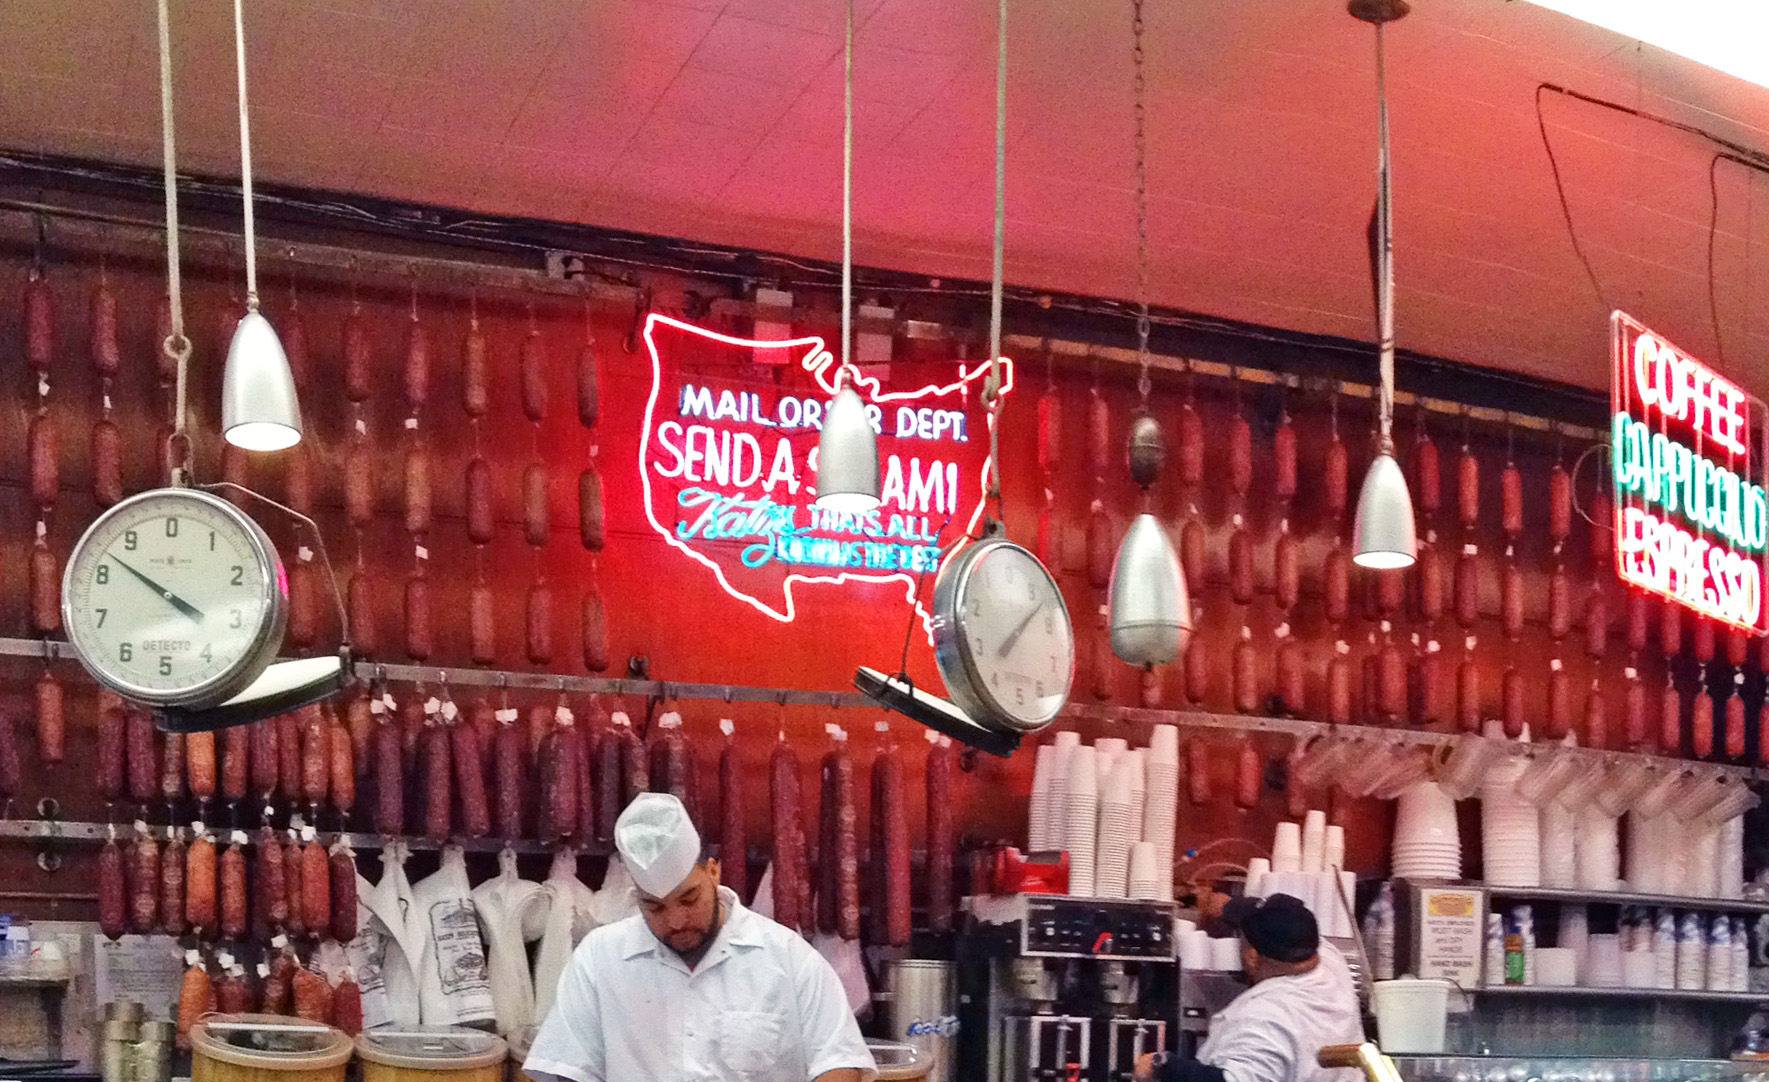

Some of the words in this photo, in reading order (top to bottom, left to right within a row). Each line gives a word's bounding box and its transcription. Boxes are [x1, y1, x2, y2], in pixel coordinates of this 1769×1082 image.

[1634, 334, 1746, 456] COFFEE
[680, 384, 777, 427] MAIL
[778, 396, 884, 435] ORR
[895, 407, 969, 442] DEPT.
[653, 421, 762, 488] SEND
[762, 437, 799, 495] A
[1612, 411, 1767, 550] CAPPUCCINO
[165, 517, 179, 538] 0
[124, 530, 138, 551] 9
[208, 531, 216, 552] 1
[96, 564, 109, 585] 8
[230, 565, 244, 586] 2
[1624, 507, 1761, 627] ESPRESSO
[95, 608, 108, 628] 7
[229, 609, 243, 630] 3
[119, 643, 133, 662] 6
[142, 640, 192, 652] DETECTO
[159, 656, 173, 676] 5
